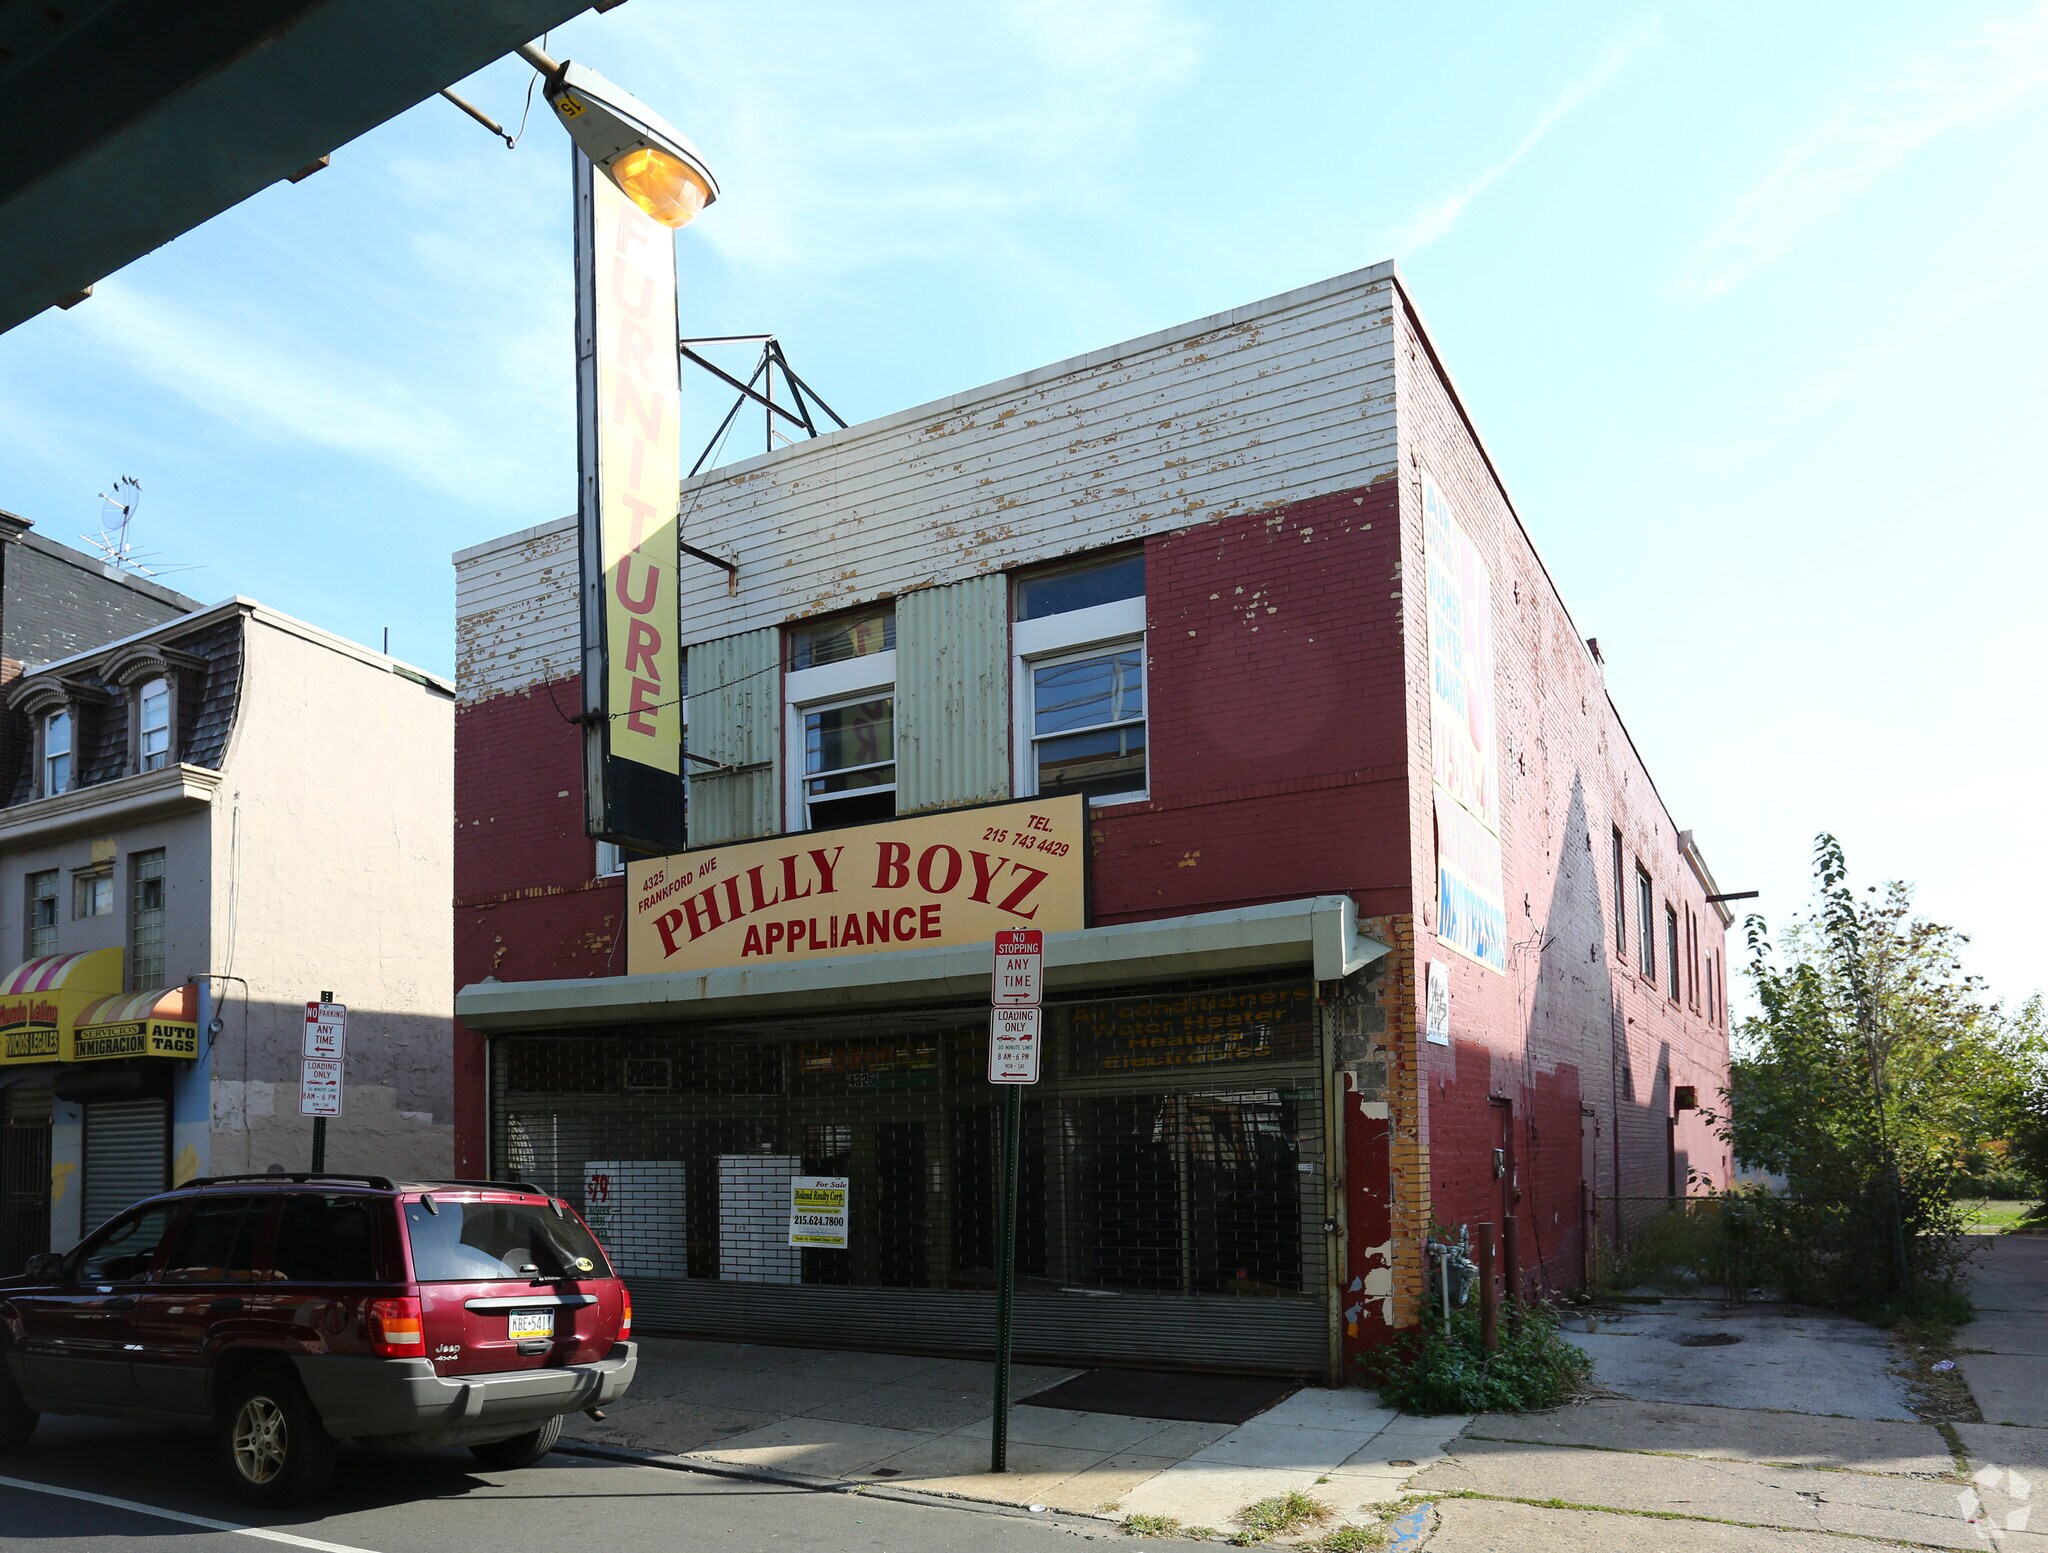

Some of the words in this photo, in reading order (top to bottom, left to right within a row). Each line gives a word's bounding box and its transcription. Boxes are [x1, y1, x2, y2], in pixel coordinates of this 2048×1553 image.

[561, 97, 581, 116] 15
[611, 202, 662, 737] FURNITURE
[1027, 814, 1053, 833] TEL.
[982, 827, 1009, 843] 215
[1011, 832, 1037, 849] 743
[1036, 838, 1070, 857] 4429
[638, 871, 693, 914] FRANKFORD
[698, 857, 717, 878] AVE
[643, 870, 664, 892] 4325
[652, 845, 845, 960] PHILLY
[872, 841, 1049, 920] BOYZ
[740, 903, 942, 958] APPLIANCE
[1012, 933, 1025, 943] NO
[998, 943, 1039, 954] STOPPING
[1006, 959, 1030, 971] ANY
[1004, 975, 1031, 987] TIME
[30, 998, 58, 1022] Latino
[307, 1007, 318, 1018] NO
[319, 1009, 344, 1019] PARKING
[998, 1010, 1033, 1021] LOADING
[82, 1025, 138, 1040] SERVICIOS
[152, 1025, 195, 1039] AUTO
[316, 1025, 334, 1034] ANY
[1004, 1022, 1026, 1032] ONLY
[30, 1031, 58, 1054] LEGALES
[76, 1036, 146, 1057] INMIGRACION
[153, 1038, 195, 1052] TAGS
[315, 1035, 334, 1045] TIME
[308, 1062, 337, 1071] LOADING
[313, 1070, 331, 1079] ONLY
[849, 1072, 875, 1087] 4325
[328, 1093, 336, 1101] PM
[588, 1174, 609, 1203] $79
[816, 1180, 829, 1188] For
[830, 1181, 847, 1189] Sale
[795, 1190, 813, 1201] Boland
[814, 1190, 829, 1204] Realty
[794, 1215, 844, 1227] 215.624.7800
[435, 1343, 461, 1354] Jeep
